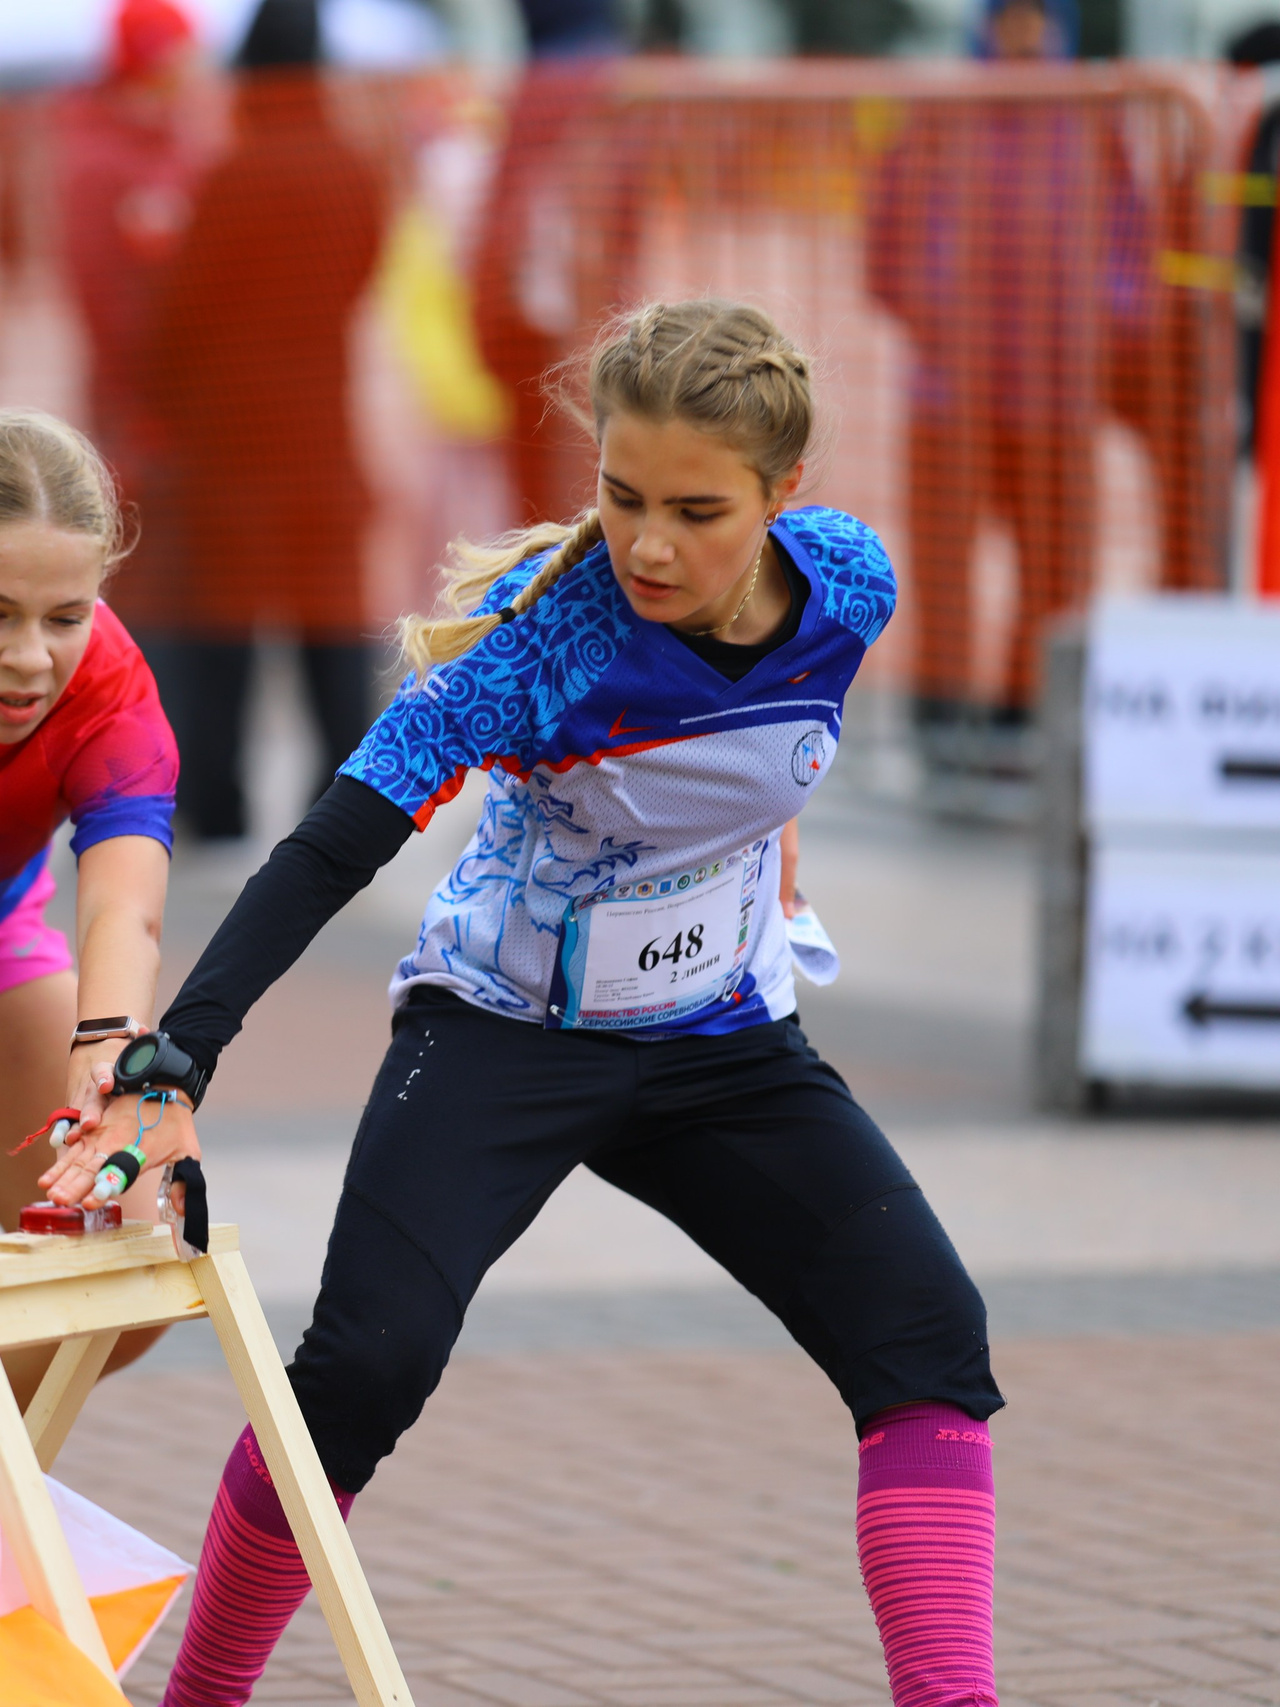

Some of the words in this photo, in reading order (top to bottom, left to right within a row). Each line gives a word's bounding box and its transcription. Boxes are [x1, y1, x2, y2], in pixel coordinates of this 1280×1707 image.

[638, 923, 705, 972] 648
[669, 970, 679, 984] 2
[577, 1007, 640, 1019] ПЕРВЕНСТВО
[641, 1000, 677, 1015] РОССИИ
